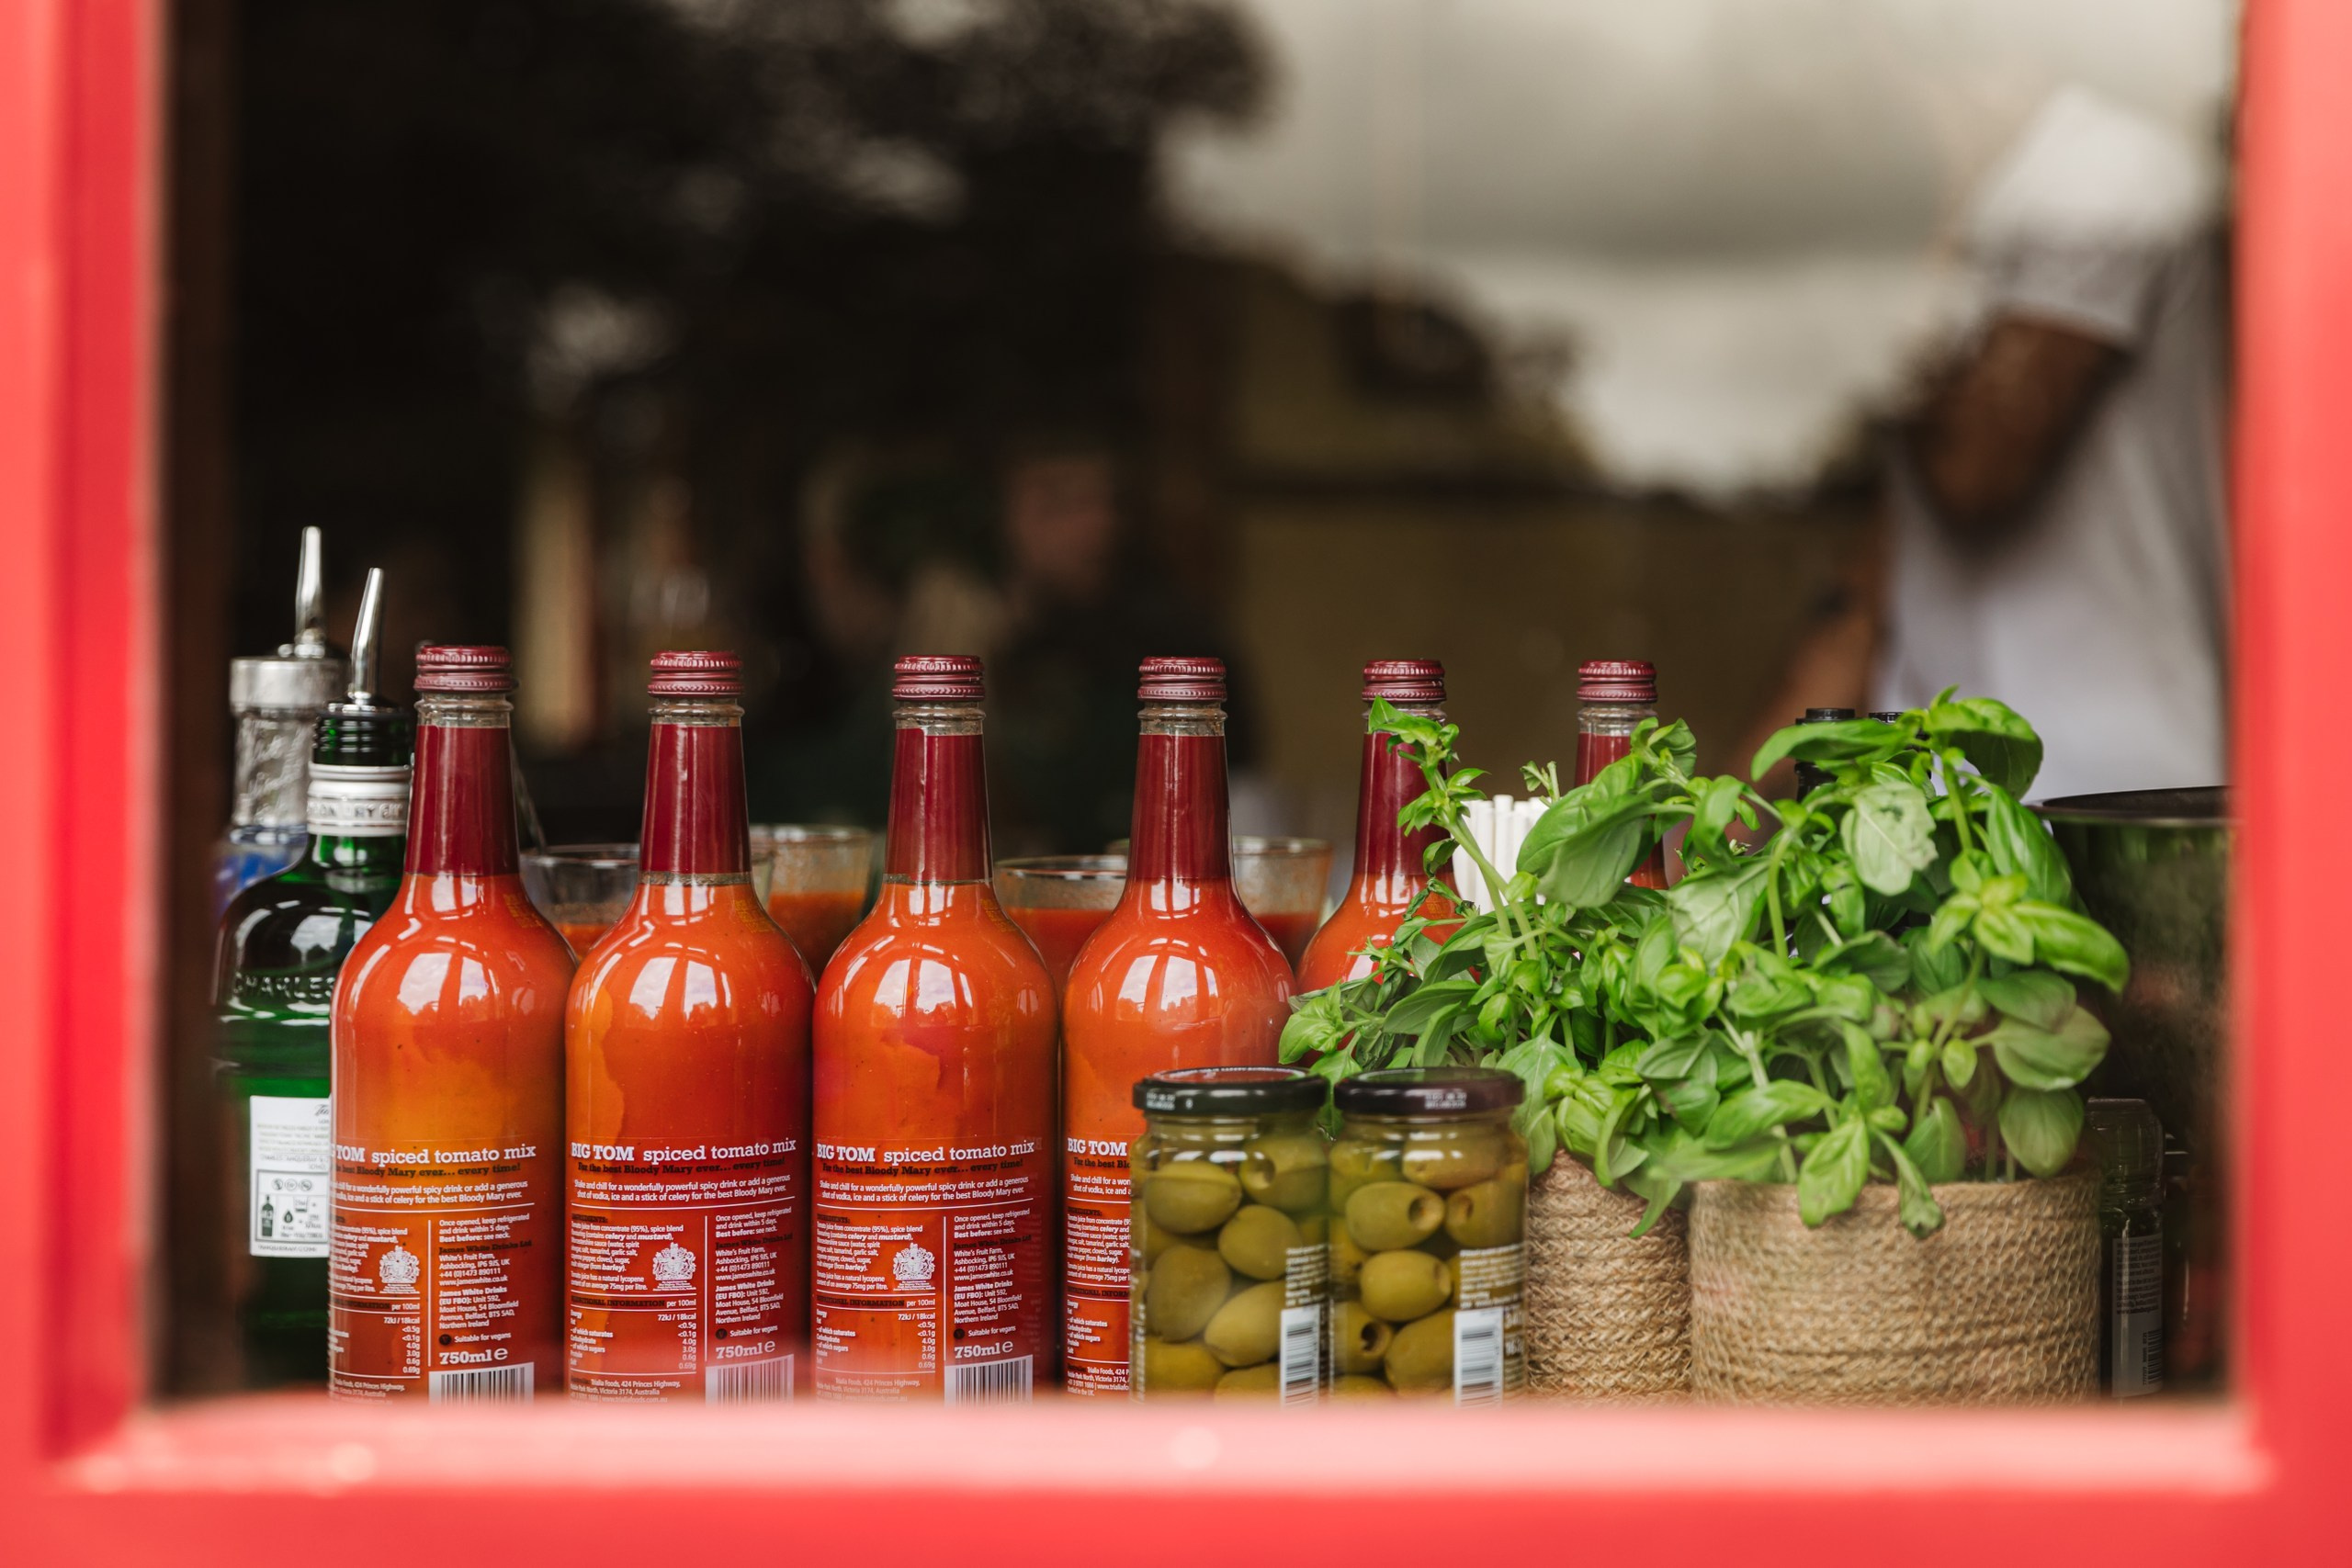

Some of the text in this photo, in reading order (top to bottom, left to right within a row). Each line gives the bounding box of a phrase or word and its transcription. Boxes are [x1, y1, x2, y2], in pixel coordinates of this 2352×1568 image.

[571, 1137, 797, 1166] BIG TOM spiced tomato mix
[817, 1139, 1035, 1167] BIG TOM spiced tomato mix
[1067, 1137, 1128, 1156] BIG TOM
[371, 1148, 430, 1168] spiced
[435, 1148, 500, 1164] tomato
[503, 1144, 537, 1159] mix
[1084, 1157, 1095, 1167] the
[1097, 1158, 1114, 1168] best
[356, 1166, 385, 1178] Bloody
[388, 1168, 416, 1179] Mary
[458, 1167, 490, 1176] every
[492, 1162, 522, 1173] time!
[589, 1164, 602, 1172] the
[603, 1165, 622, 1173] best
[624, 1165, 660, 1176] Bloody
[662, 1165, 695, 1175] Mary
[733, 1162, 762, 1171] every
[832, 1164, 843, 1173] the
[845, 1165, 863, 1174] best
[865, 1166, 899, 1177] Bloody
[901, 1166, 932, 1176] Mary
[970, 1163, 999, 1172] every
[1000, 1158, 1023, 1168] time!
[390, 1185, 422, 1195] powerful
[424, 1185, 442, 1195] spicy
[443, 1185, 463, 1194] drink
[474, 1182, 489, 1192] add
[497, 1180, 528, 1192] generous
[608, 1182, 617, 1190] for
[625, 1183, 664, 1193] wonderfully
[665, 1182, 698, 1193] powerful
[700, 1182, 718, 1192] spicy
[719, 1179, 738, 1190] drink
[748, 1178, 761, 1187] add
[766, 1175, 791, 1186] generous
[851, 1183, 860, 1191] for
[865, 1183, 905, 1194] wonderfully
[906, 1183, 937, 1194] powerful
[939, 1182, 957, 1192] spicy
[958, 1181, 976, 1190] drink
[986, 1179, 999, 1188] add
[1004, 1177, 1029, 1187] generous
[1114, 1187, 1126, 1195] and
[370, 1195, 384, 1203] stick
[385, 1195, 392, 1203] of
[393, 1195, 413, 1205] celery
[415, 1195, 425, 1203] for
[426, 1195, 439, 1203] the
[441, 1194, 458, 1203] best
[458, 1194, 484, 1204] Bloody
[486, 1193, 505, 1201] Mary
[611, 1192, 620, 1201] ice
[621, 1193, 634, 1201] and
[641, 1193, 658, 1201] stick
[659, 1193, 667, 1201] of
[668, 1192, 691, 1202] celery
[692, 1191, 703, 1201] for
[704, 1190, 717, 1200] the
[718, 1189, 733, 1199] best
[734, 1188, 758, 1197] Bloody
[758, 1186, 775, 1195] Mary
[853, 1193, 862, 1201] ice
[882, 1193, 898, 1202] stick
[899, 1193, 907, 1201] of
[908, 1192, 929, 1202] celery
[931, 1192, 942, 1201] for
[943, 1191, 955, 1201] the
[956, 1190, 971, 1200] best
[972, 1189, 995, 1199] Bloody
[995, 1188, 1012, 1197] Mary
[1012, 1186, 1025, 1194] ever.
[650, 1224, 665, 1233] spice
[457, 1234, 482, 1242] before:
[605, 1233, 625, 1241] celery
[975, 1283, 993, 1292] White
[994, 1280, 1013, 1289] Drinks
[906, 1300, 916, 1308] per
[454, 1335, 480, 1343] Suitable
[491, 1332, 512, 1341] vegans
[439, 1349, 492, 1365] 750ml
[716, 1343, 763, 1359] 750ml
[954, 1342, 1001, 1359] 750ml
